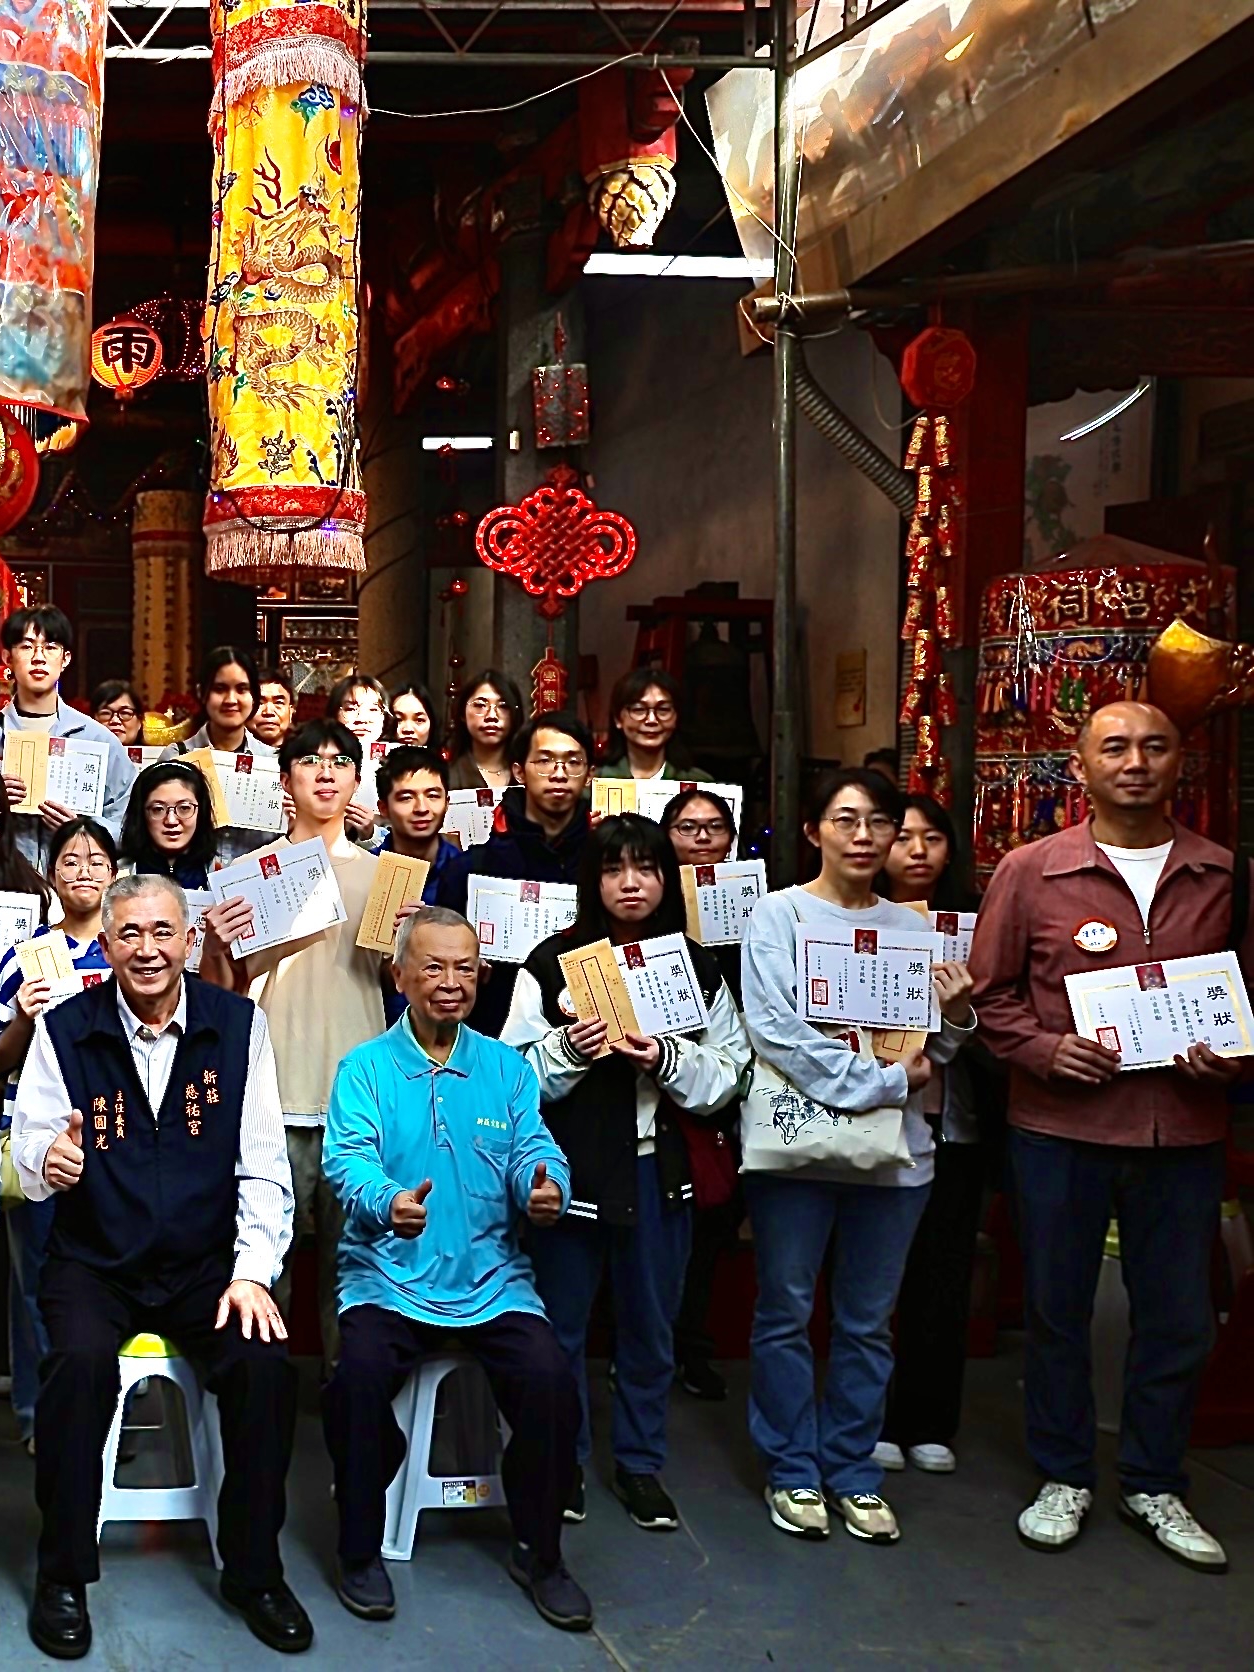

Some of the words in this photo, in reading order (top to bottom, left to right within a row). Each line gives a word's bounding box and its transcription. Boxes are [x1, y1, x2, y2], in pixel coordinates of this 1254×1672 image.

[102, 326, 156, 373] 雨
[543, 671, 556, 711] 學業
[82, 763, 95, 792] 獎狀
[670, 964, 691, 1002] 獎狀
[906, 962, 925, 1000] 獎狀
[1207, 986, 1235, 1026] 獎狀
[203, 1069, 220, 1104] 新莊
[114, 1090, 125, 1139] 主任委員
[185, 1083, 202, 1136] 慈祐宮
